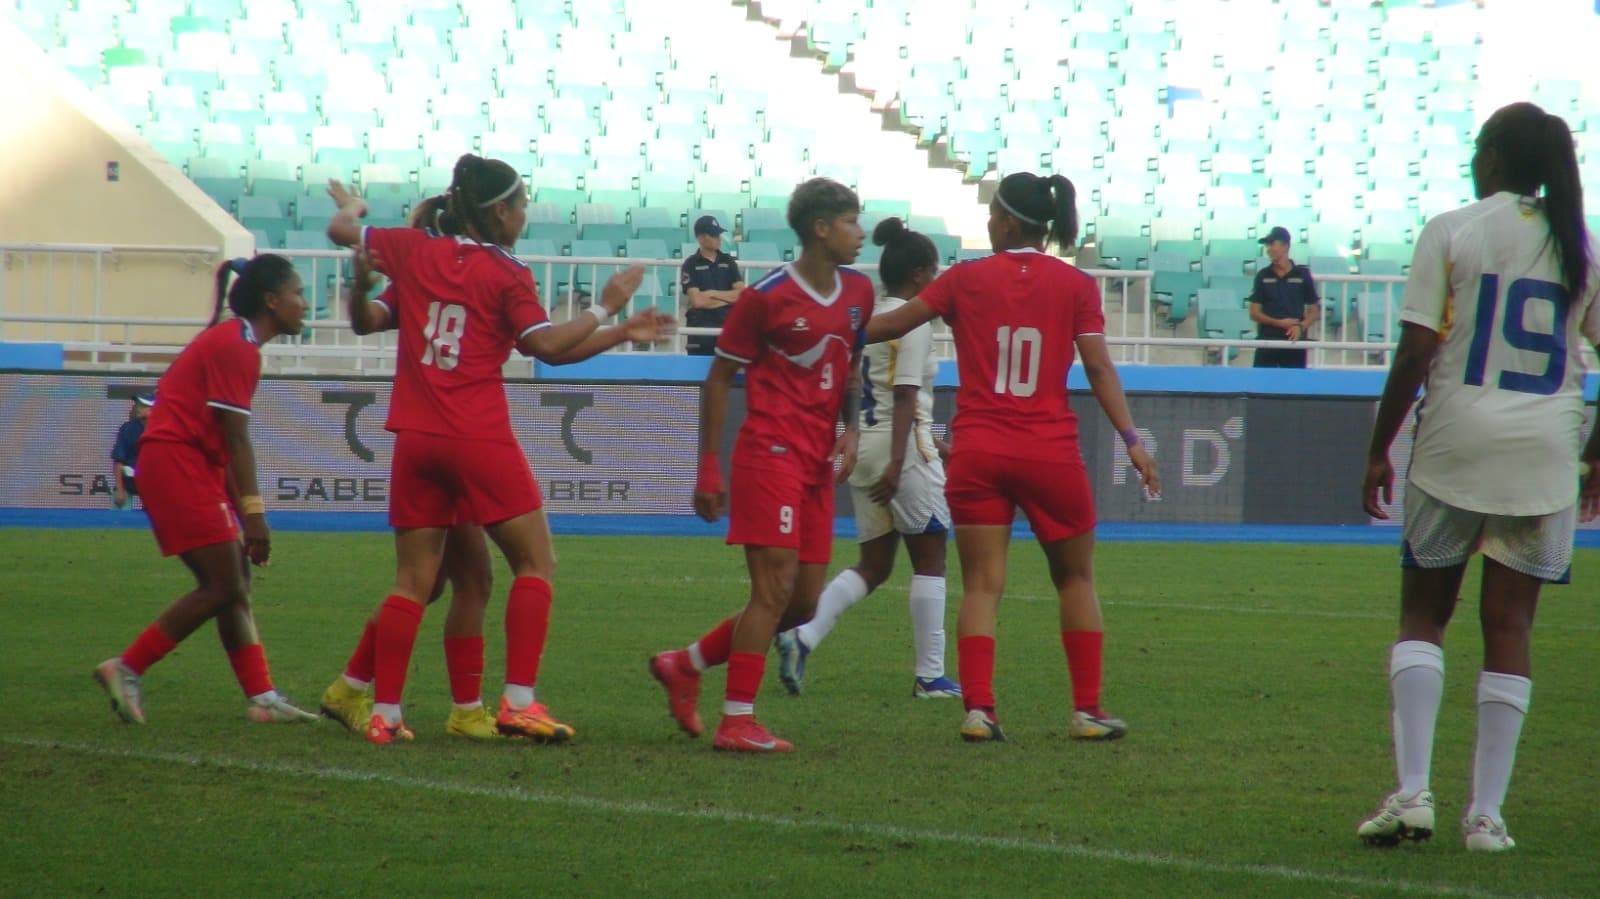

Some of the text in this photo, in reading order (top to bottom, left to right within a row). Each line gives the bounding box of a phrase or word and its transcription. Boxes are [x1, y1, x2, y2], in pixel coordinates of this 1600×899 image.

[421, 301, 467, 371] 18
[1464, 273, 1570, 396] 19
[819, 362, 833, 390] 9
[995, 326, 1042, 397] 10
[278, 478, 388, 501] SABE
[550, 480, 630, 500] BER
[779, 505, 793, 534] 9
